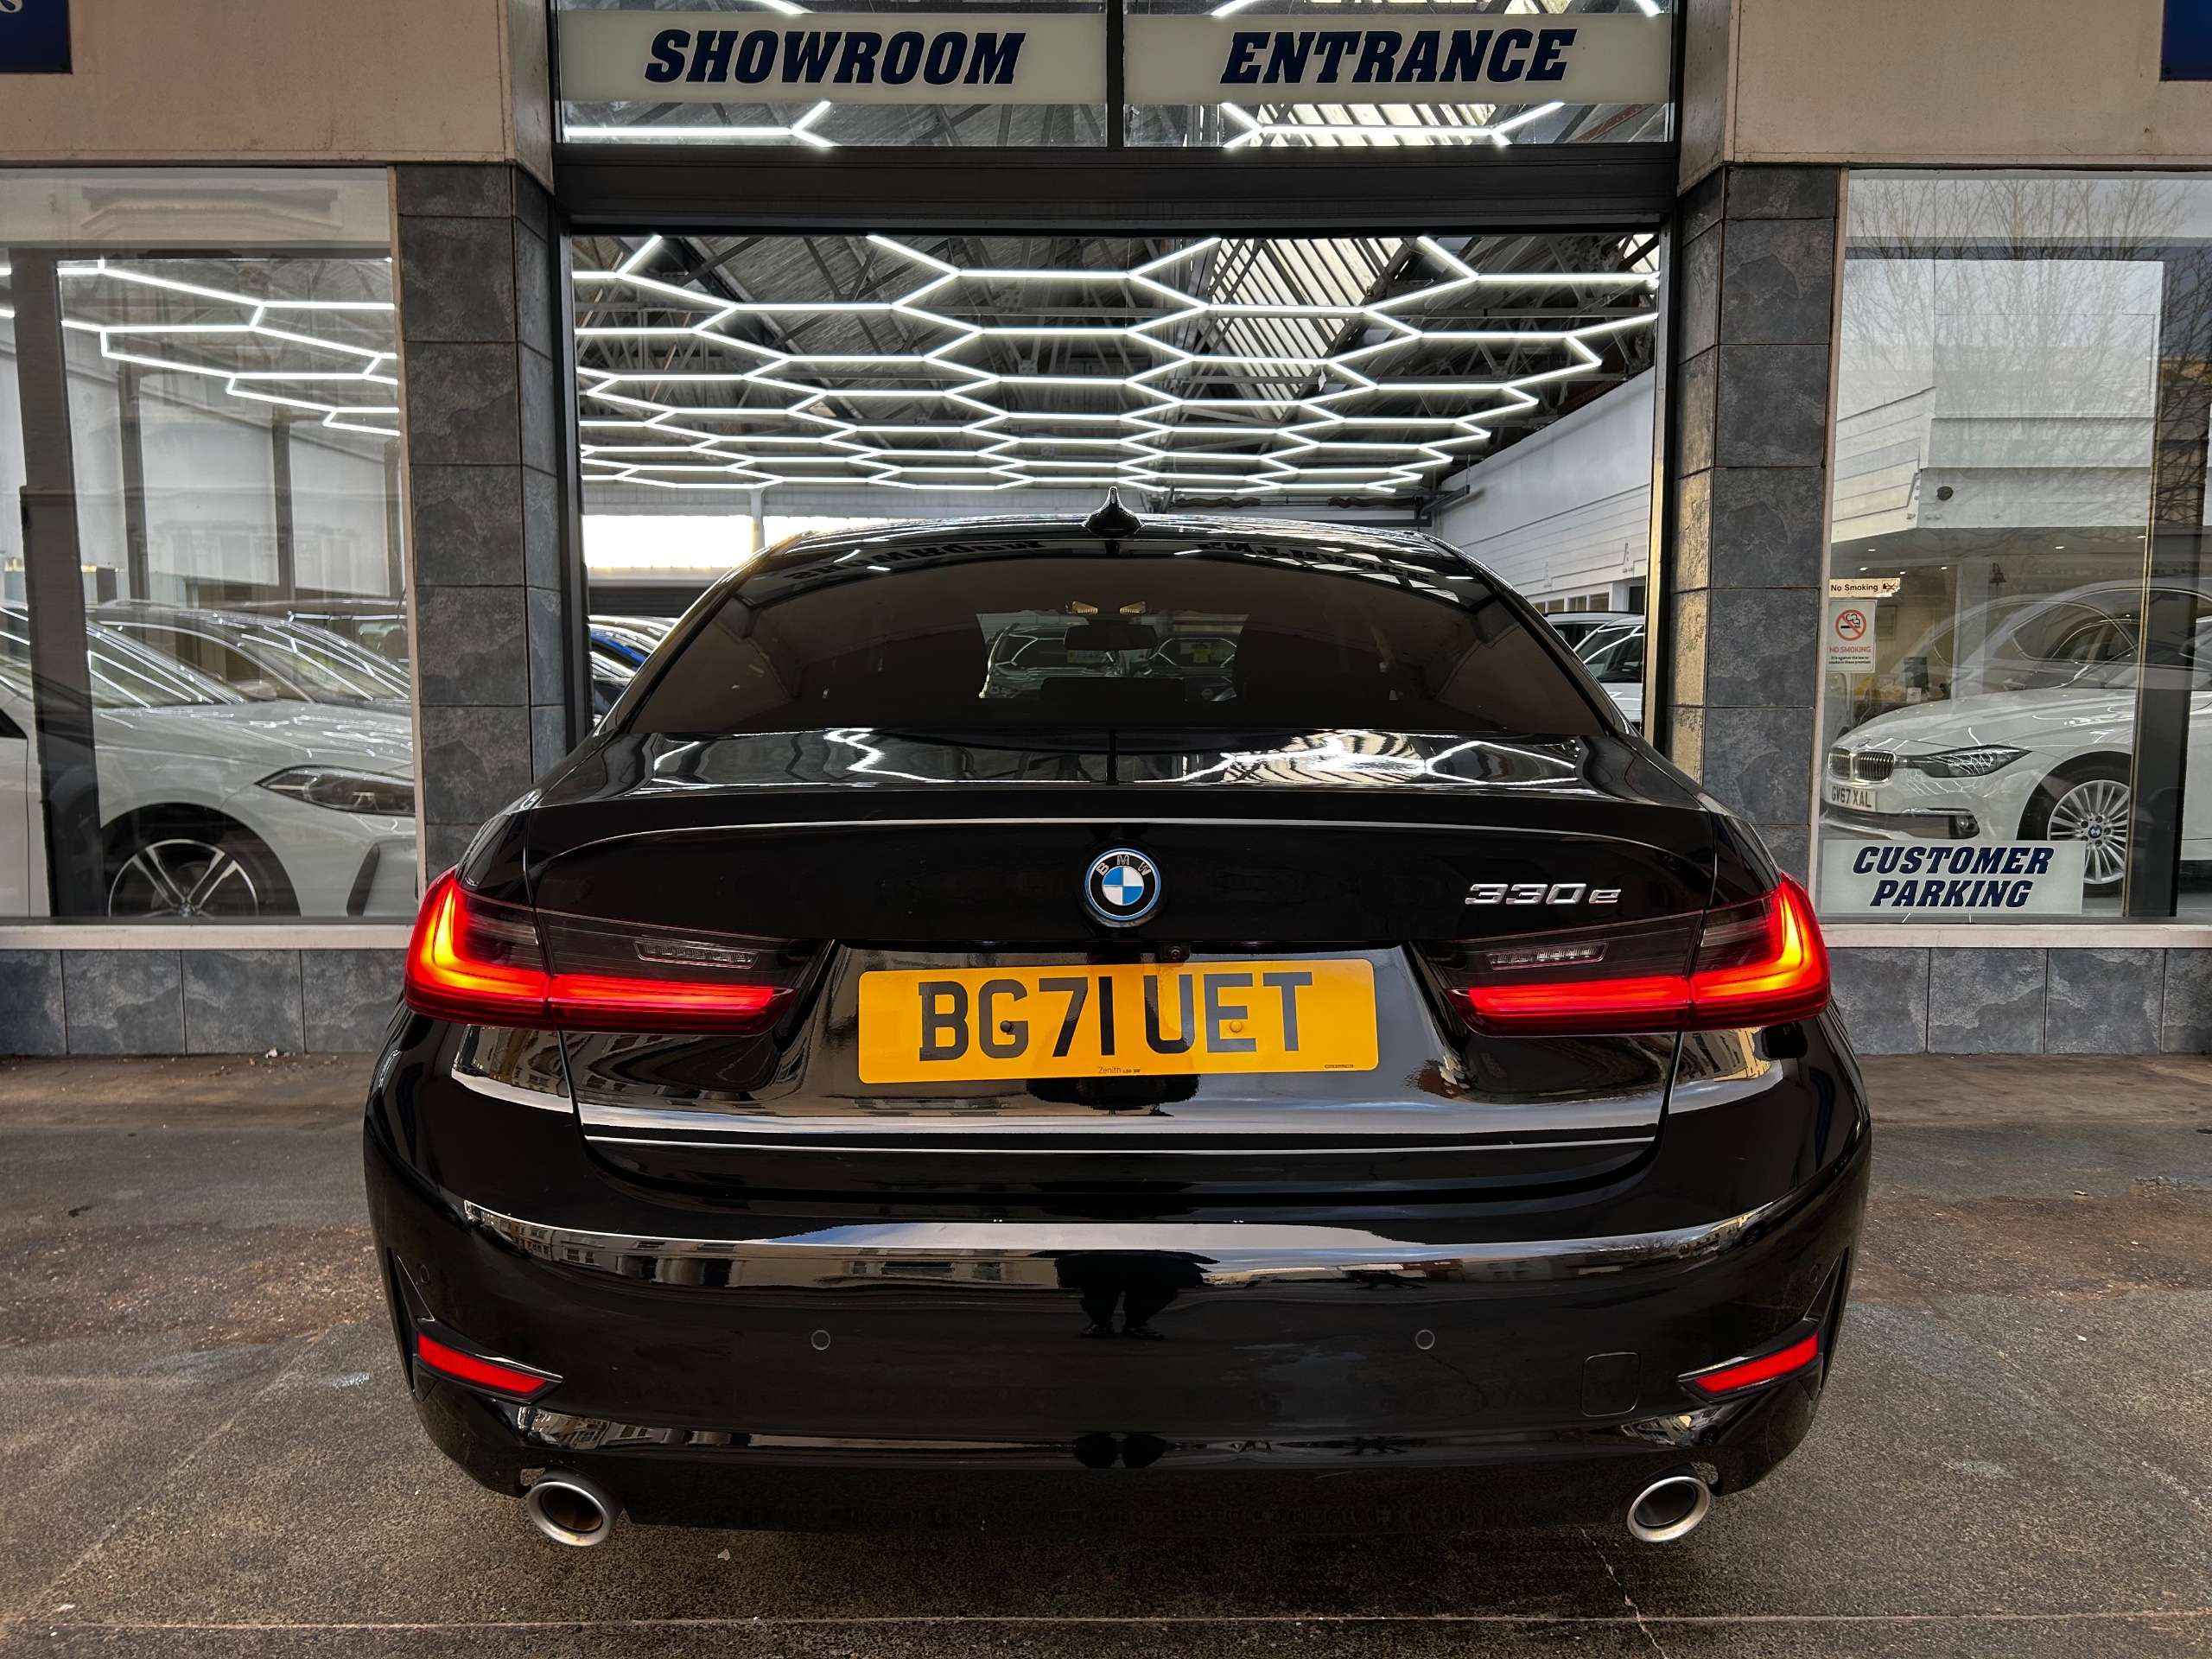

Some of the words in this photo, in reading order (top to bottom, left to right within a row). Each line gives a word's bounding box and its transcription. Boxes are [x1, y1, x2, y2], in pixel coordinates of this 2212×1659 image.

[645, 29, 1026, 85] SHOWROOM
[1219, 29, 1578, 84] ENTRANCE
[1844, 583, 1878, 592] Smoking
[1832, 785, 1851, 804] GV67
[1853, 790, 1872, 808] XAL
[1096, 855, 1152, 876] BMW
[1853, 846, 2055, 874] CUSTOMER
[1465, 883, 1622, 905] 330e
[1870, 880, 2034, 908] PARKING
[918, 976, 1116, 1061] BG71
[1143, 971, 1313, 1054] UET
